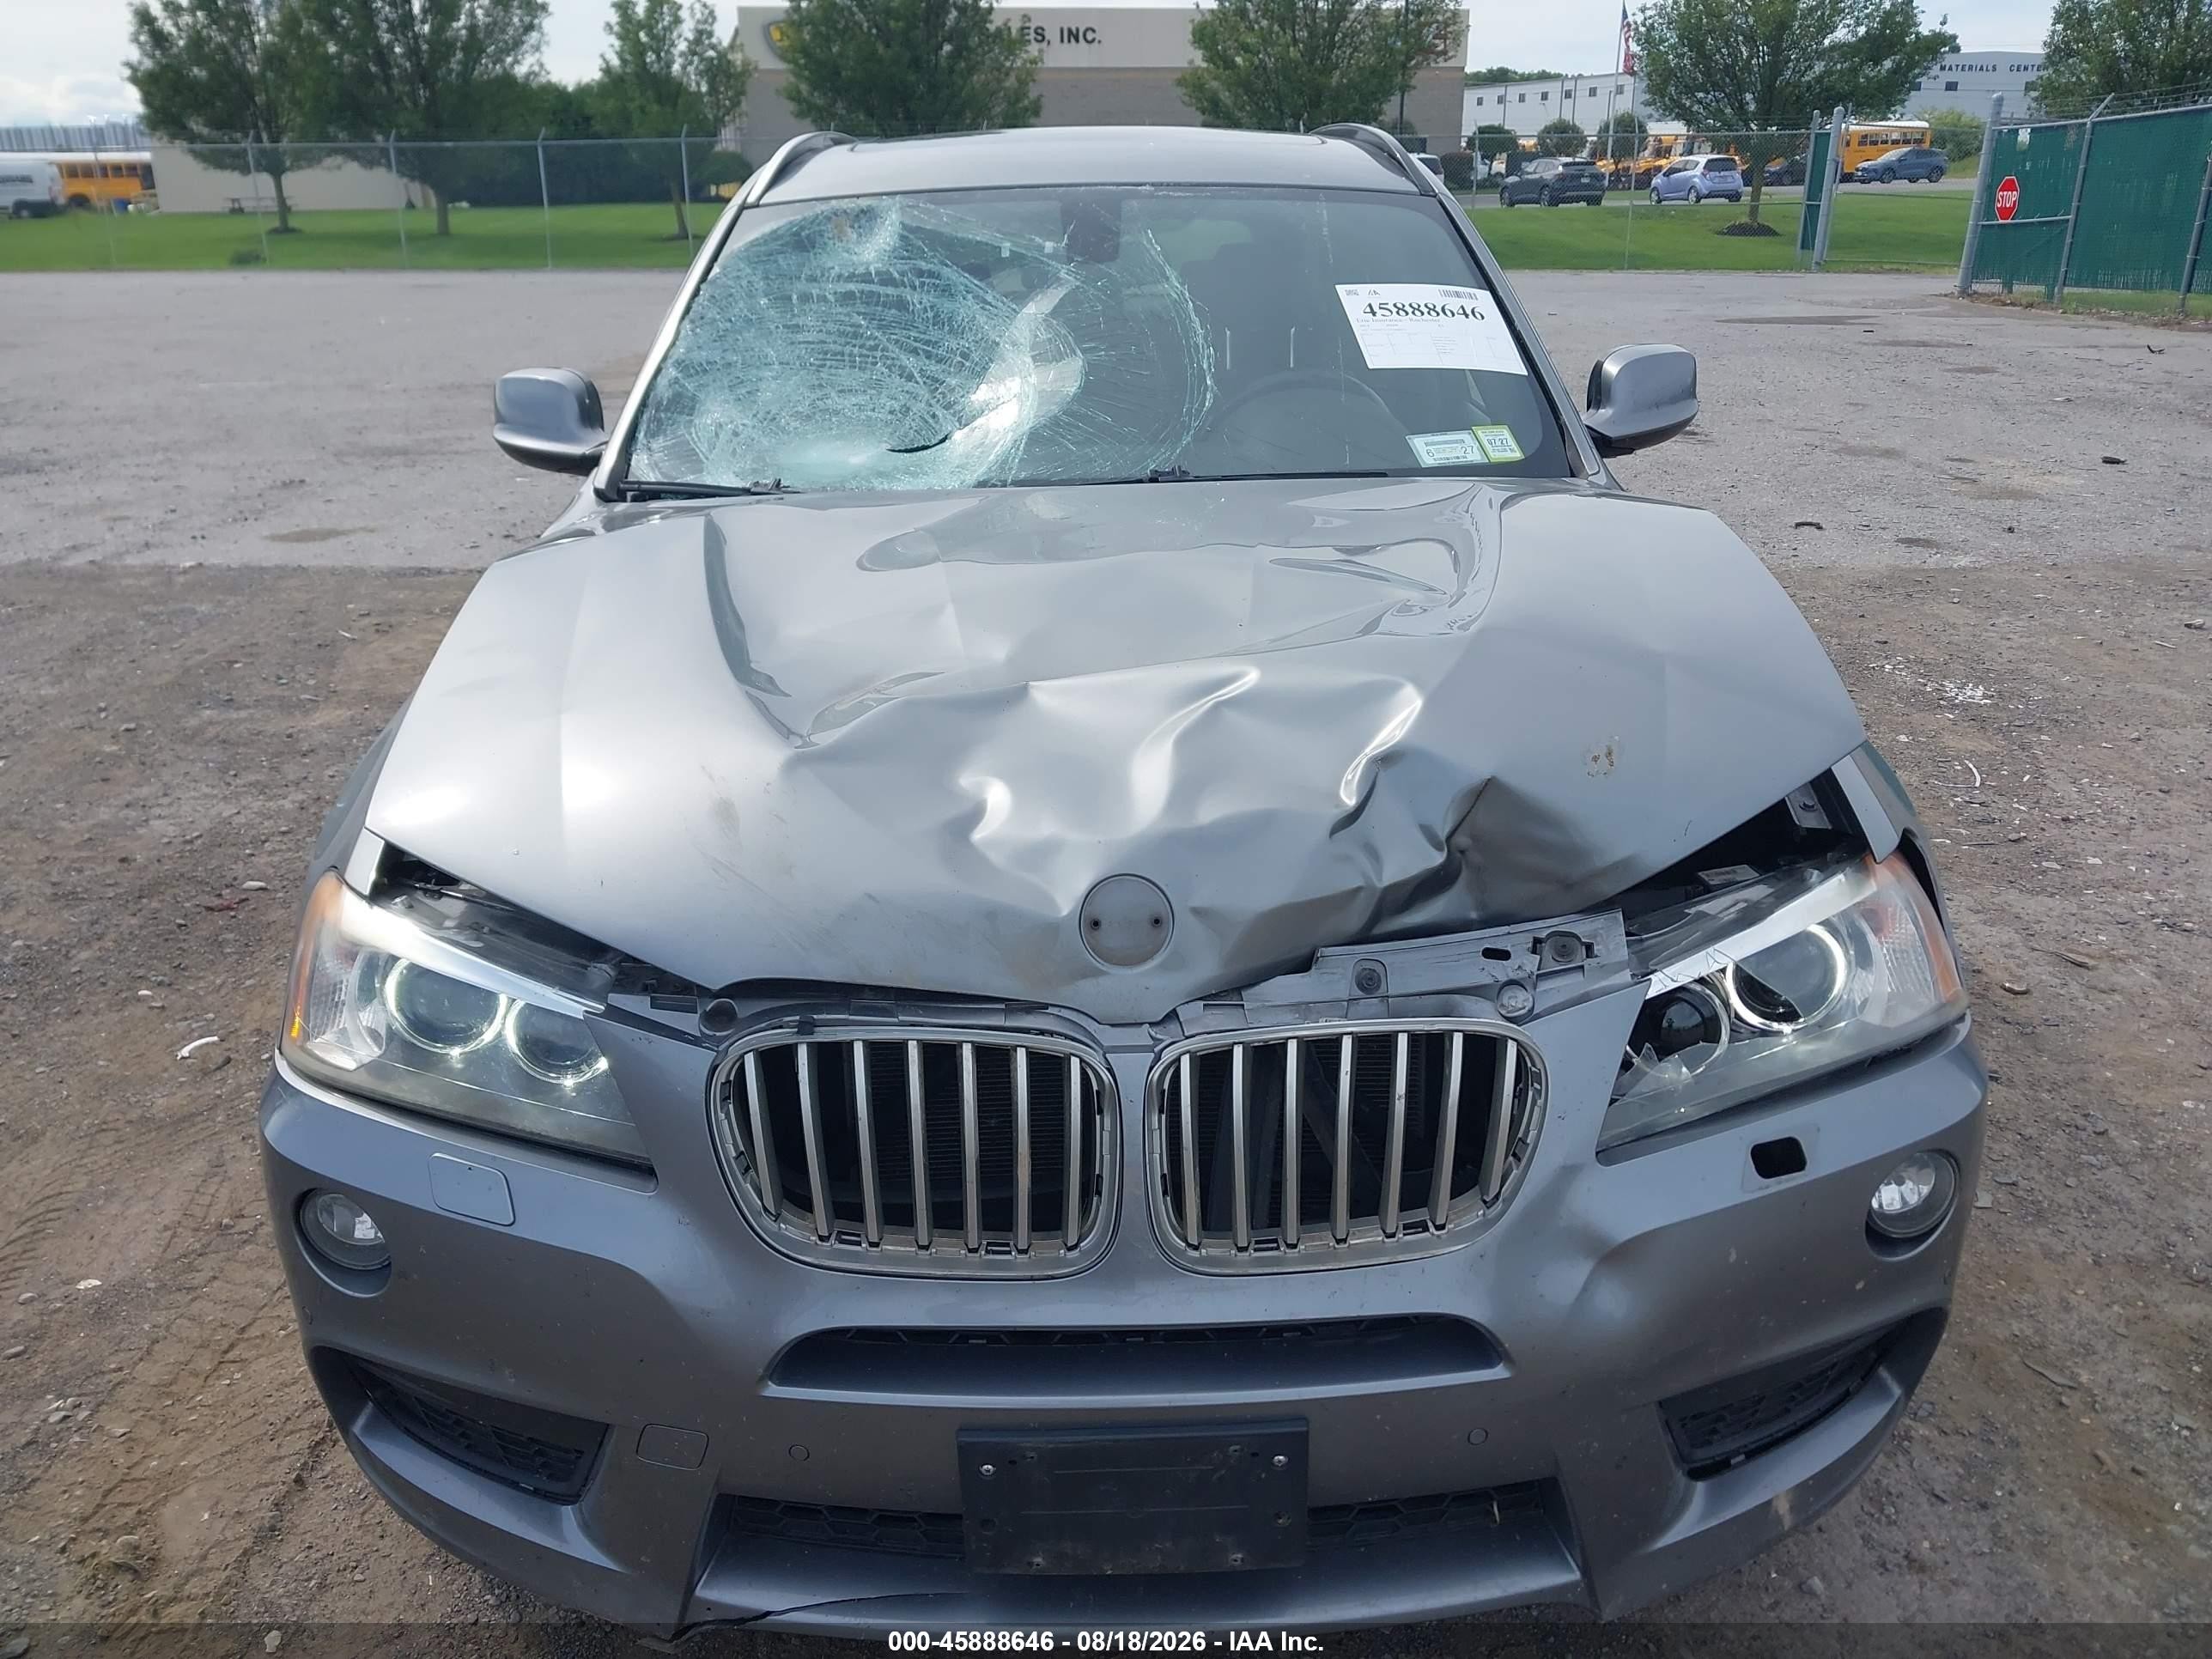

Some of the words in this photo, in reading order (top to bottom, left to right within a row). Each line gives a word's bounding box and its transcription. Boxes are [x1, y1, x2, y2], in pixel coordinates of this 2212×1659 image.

[1060, 26, 1102, 44] INC.
[1939, 64, 1997, 72] MATERIALS
[1997, 191, 2018, 208] STOP
[1363, 301, 1486, 321] 45888646
[1426, 448, 1435, 458] 6
[1461, 446, 1474, 454] 27
